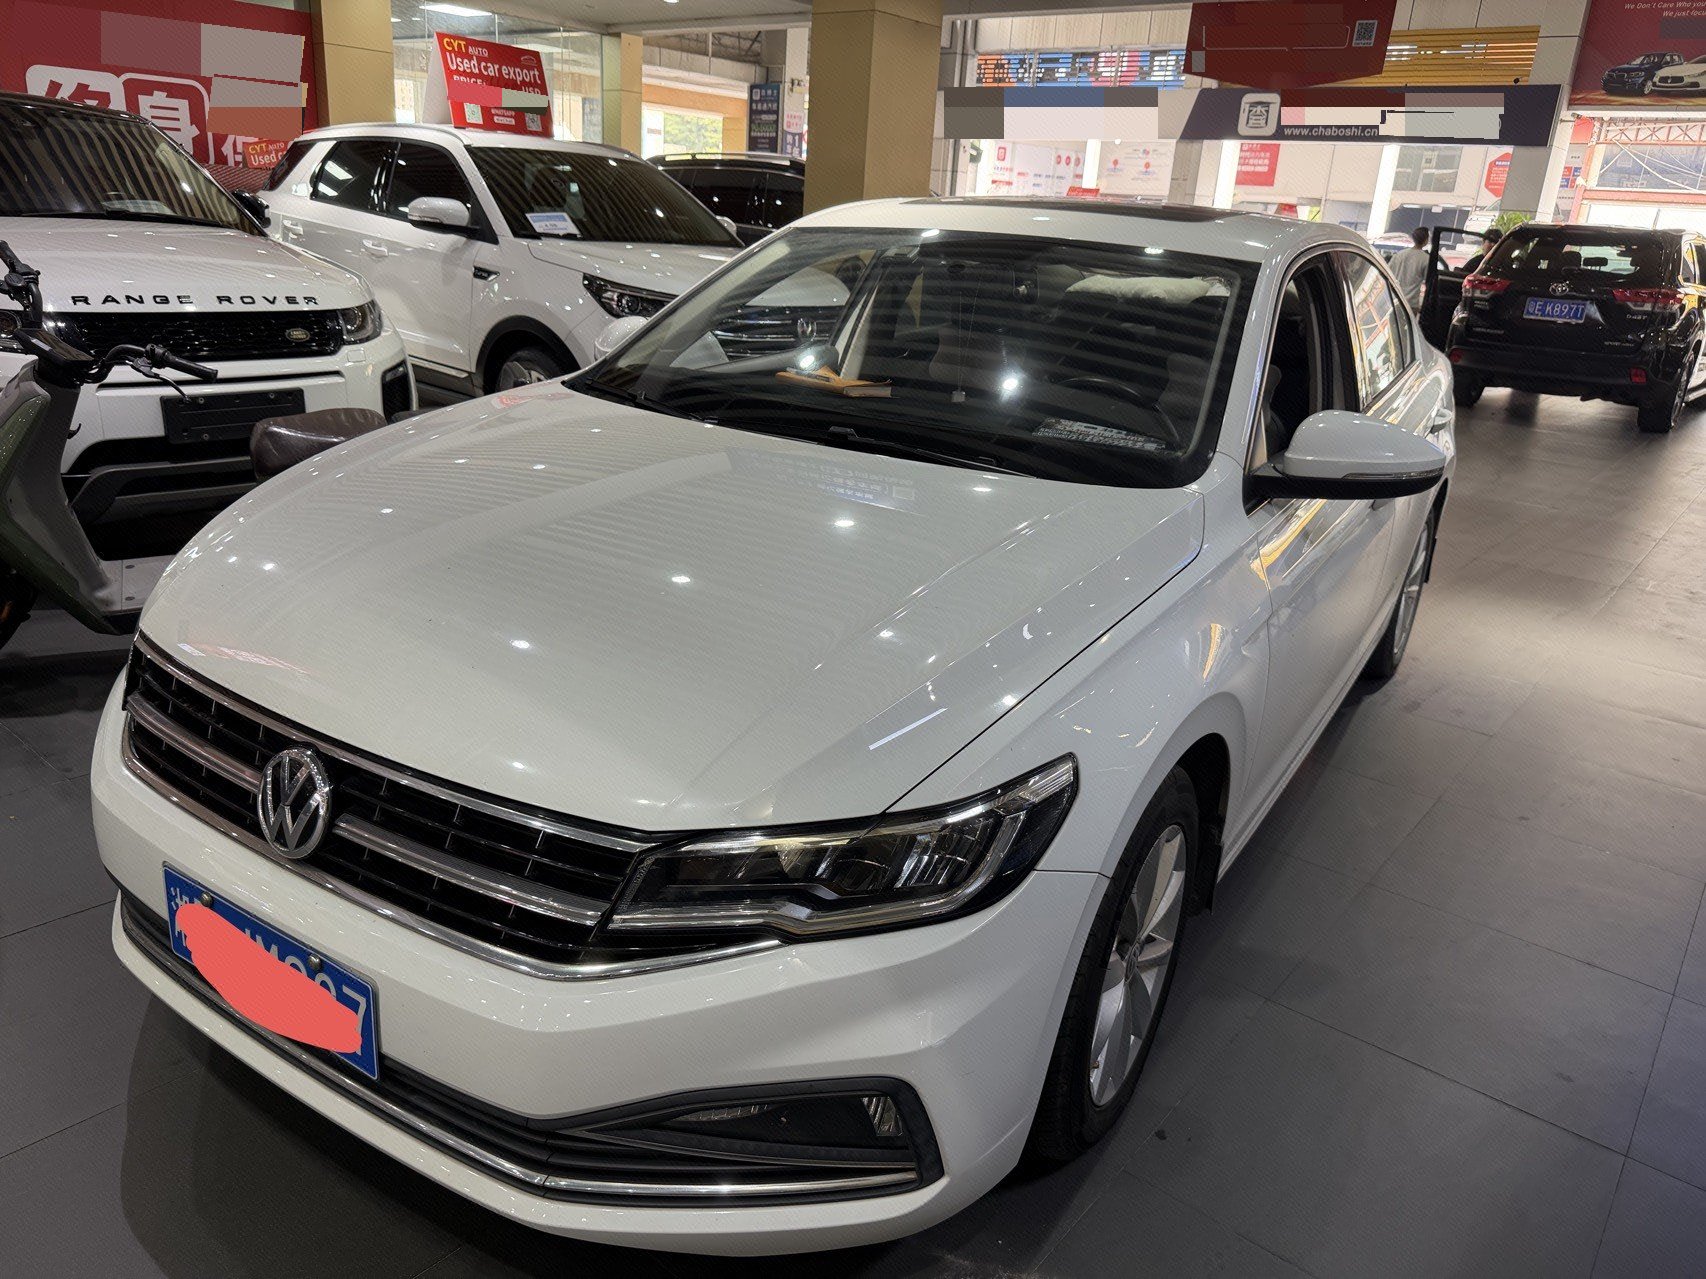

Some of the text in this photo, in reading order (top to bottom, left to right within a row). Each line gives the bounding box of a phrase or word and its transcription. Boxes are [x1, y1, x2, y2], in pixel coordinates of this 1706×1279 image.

[1673, 9, 1689, 18] just
[443, 37, 489, 57] CYT AUTO
[446, 51, 541, 85] Used car export
[1283, 125, 1378, 137] www.chaboshi.cn
[248, 143, 267, 154] CYT
[250, 150, 277, 166] Used
[70, 294, 320, 306] RANGE ROVER
